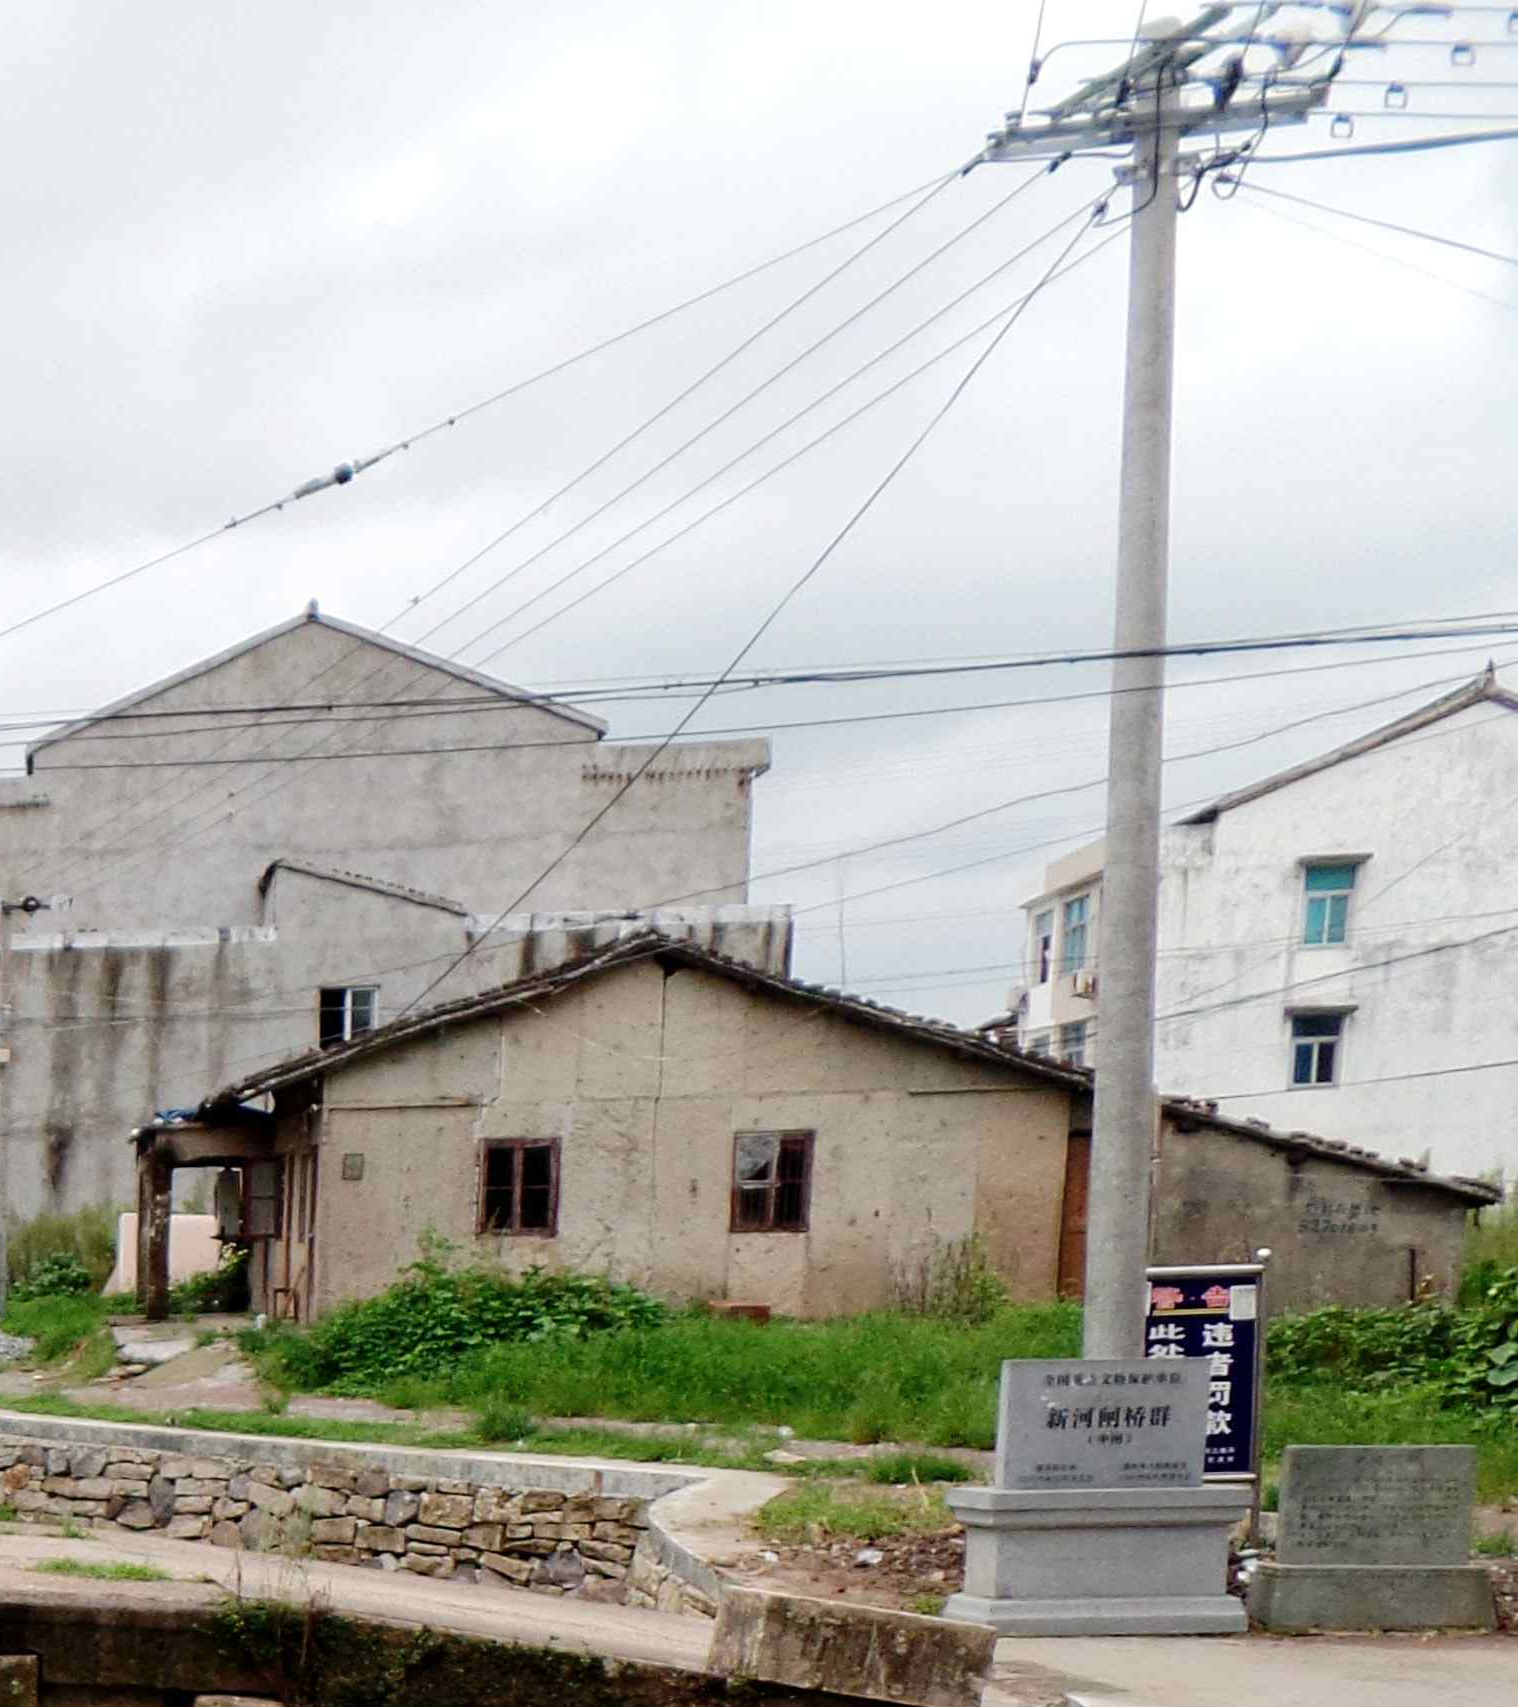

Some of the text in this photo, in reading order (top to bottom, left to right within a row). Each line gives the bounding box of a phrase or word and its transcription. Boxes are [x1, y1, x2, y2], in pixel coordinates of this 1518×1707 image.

[1046, 1404, 1173, 1430] 新河闸桥群
